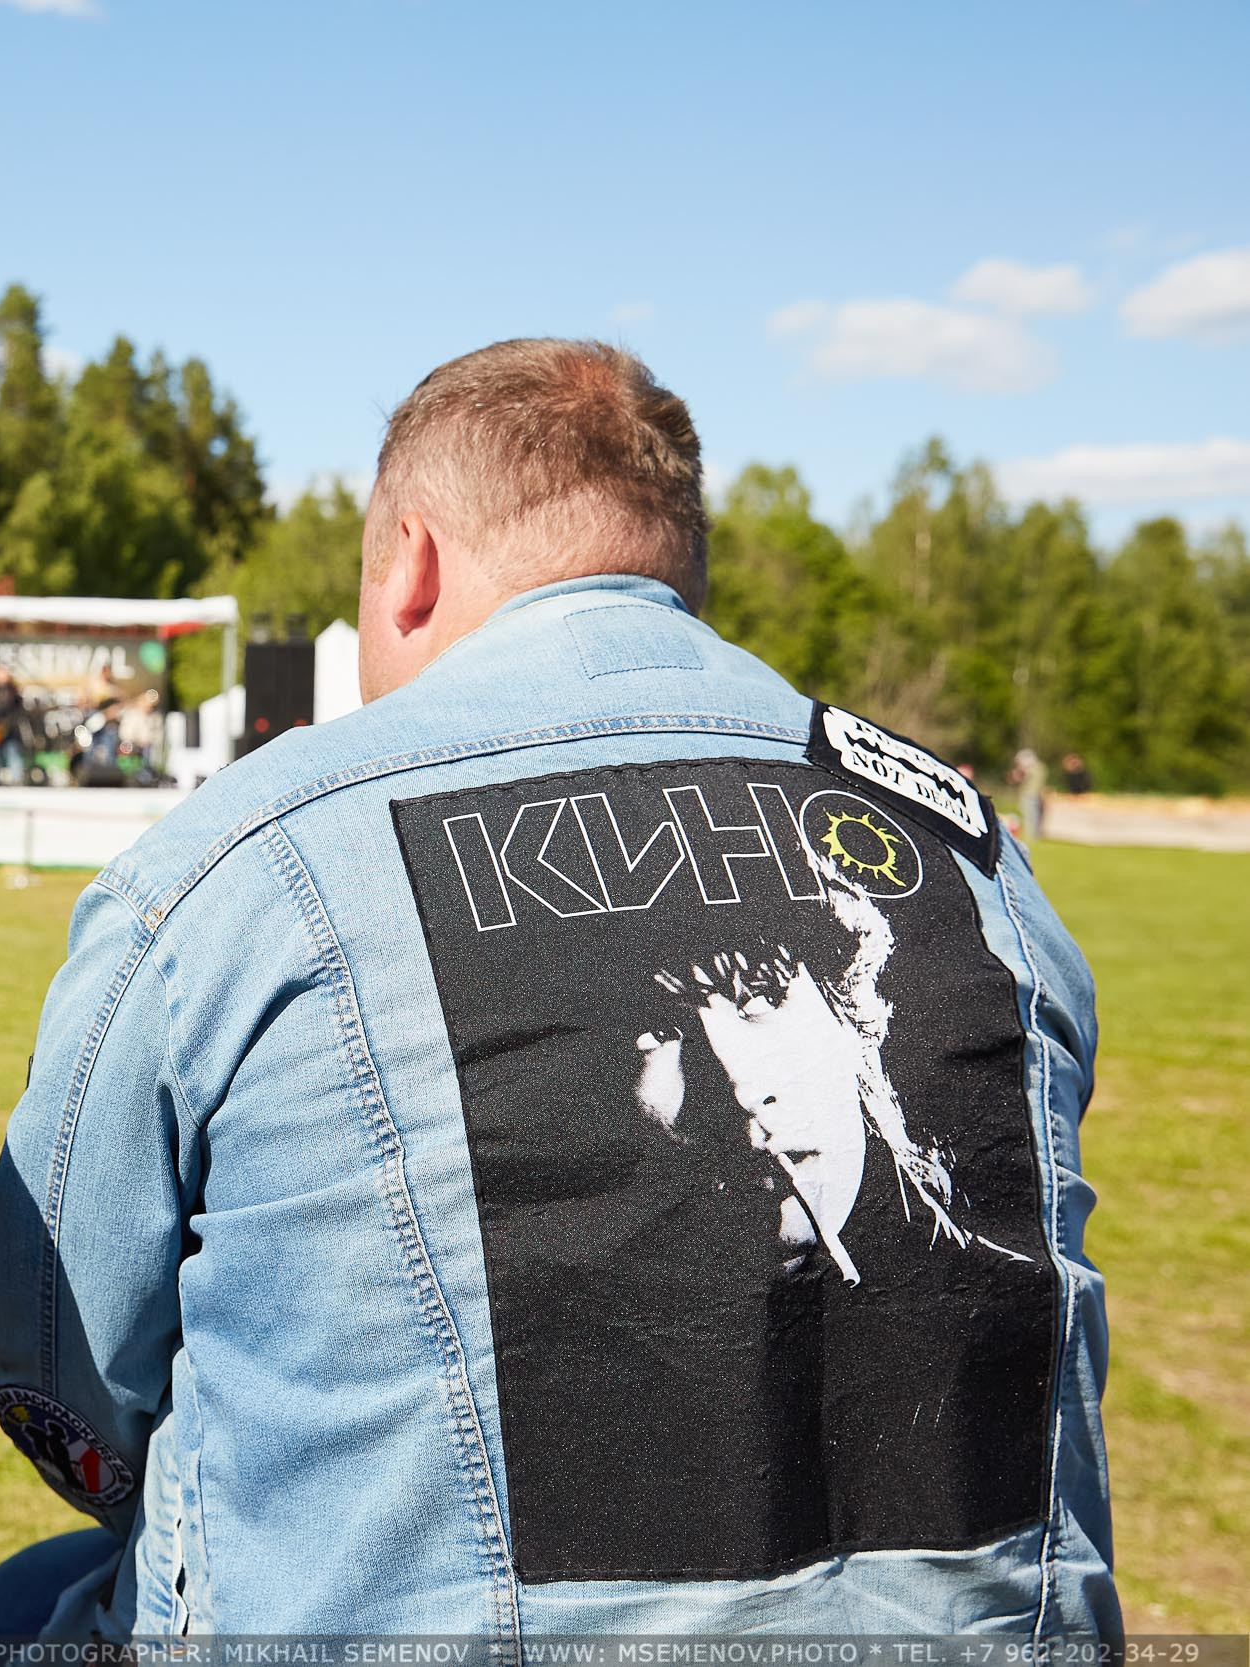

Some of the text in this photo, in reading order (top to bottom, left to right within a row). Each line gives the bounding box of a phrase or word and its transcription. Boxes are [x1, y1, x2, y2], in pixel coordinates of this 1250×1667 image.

[851, 750, 906, 787] NOT
[914, 780, 972, 825] DEAD
[442, 782, 924, 932] КИНО
